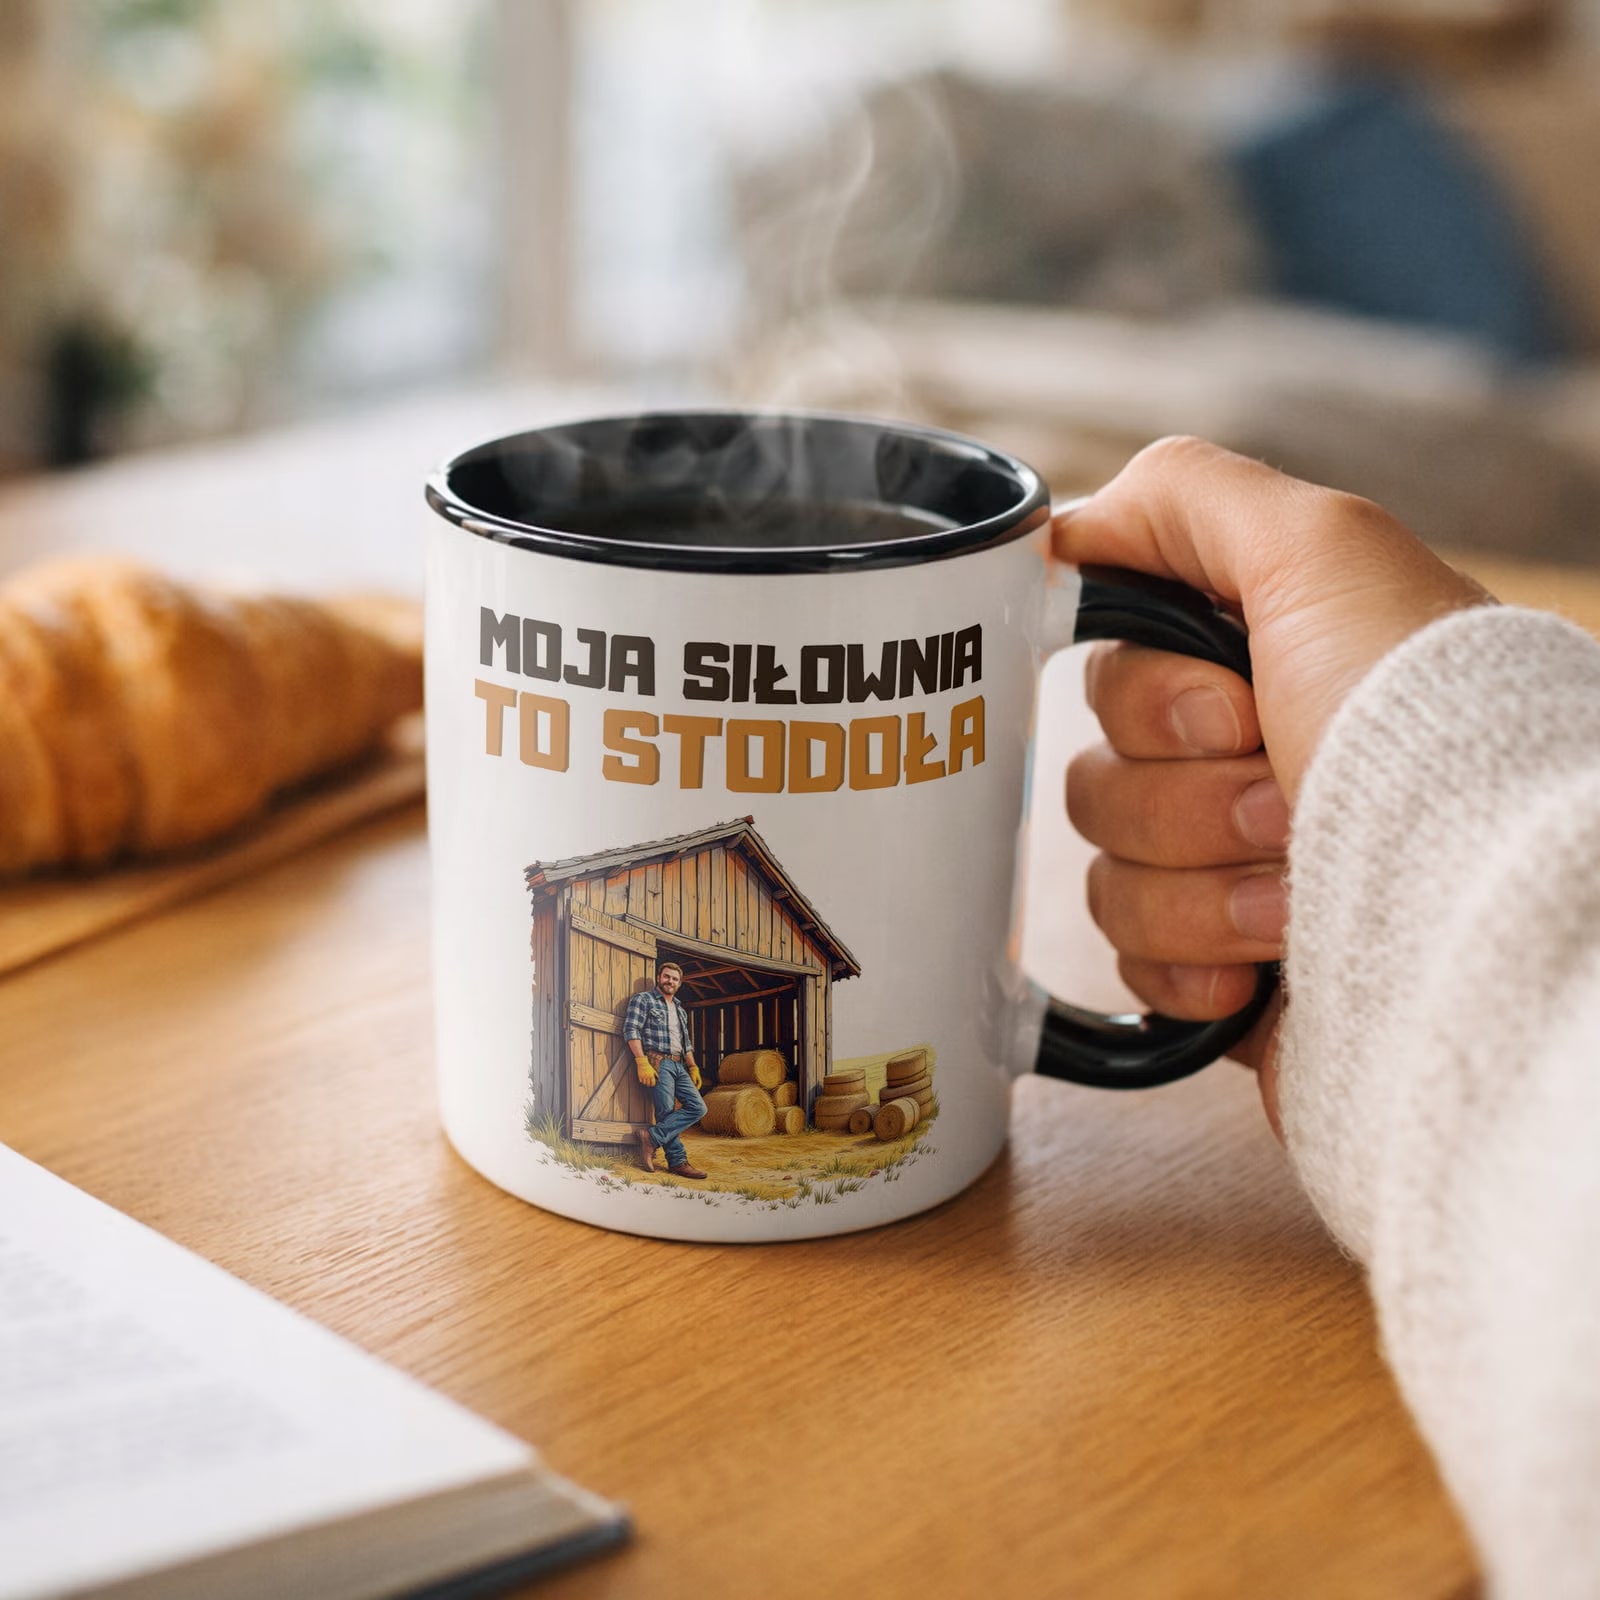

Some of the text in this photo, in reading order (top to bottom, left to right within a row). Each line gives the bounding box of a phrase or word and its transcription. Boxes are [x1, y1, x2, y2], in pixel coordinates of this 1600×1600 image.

[480, 606, 983, 705] MOJA SIŁOWNIA
[474, 678, 986, 794] TO STODOŁA
